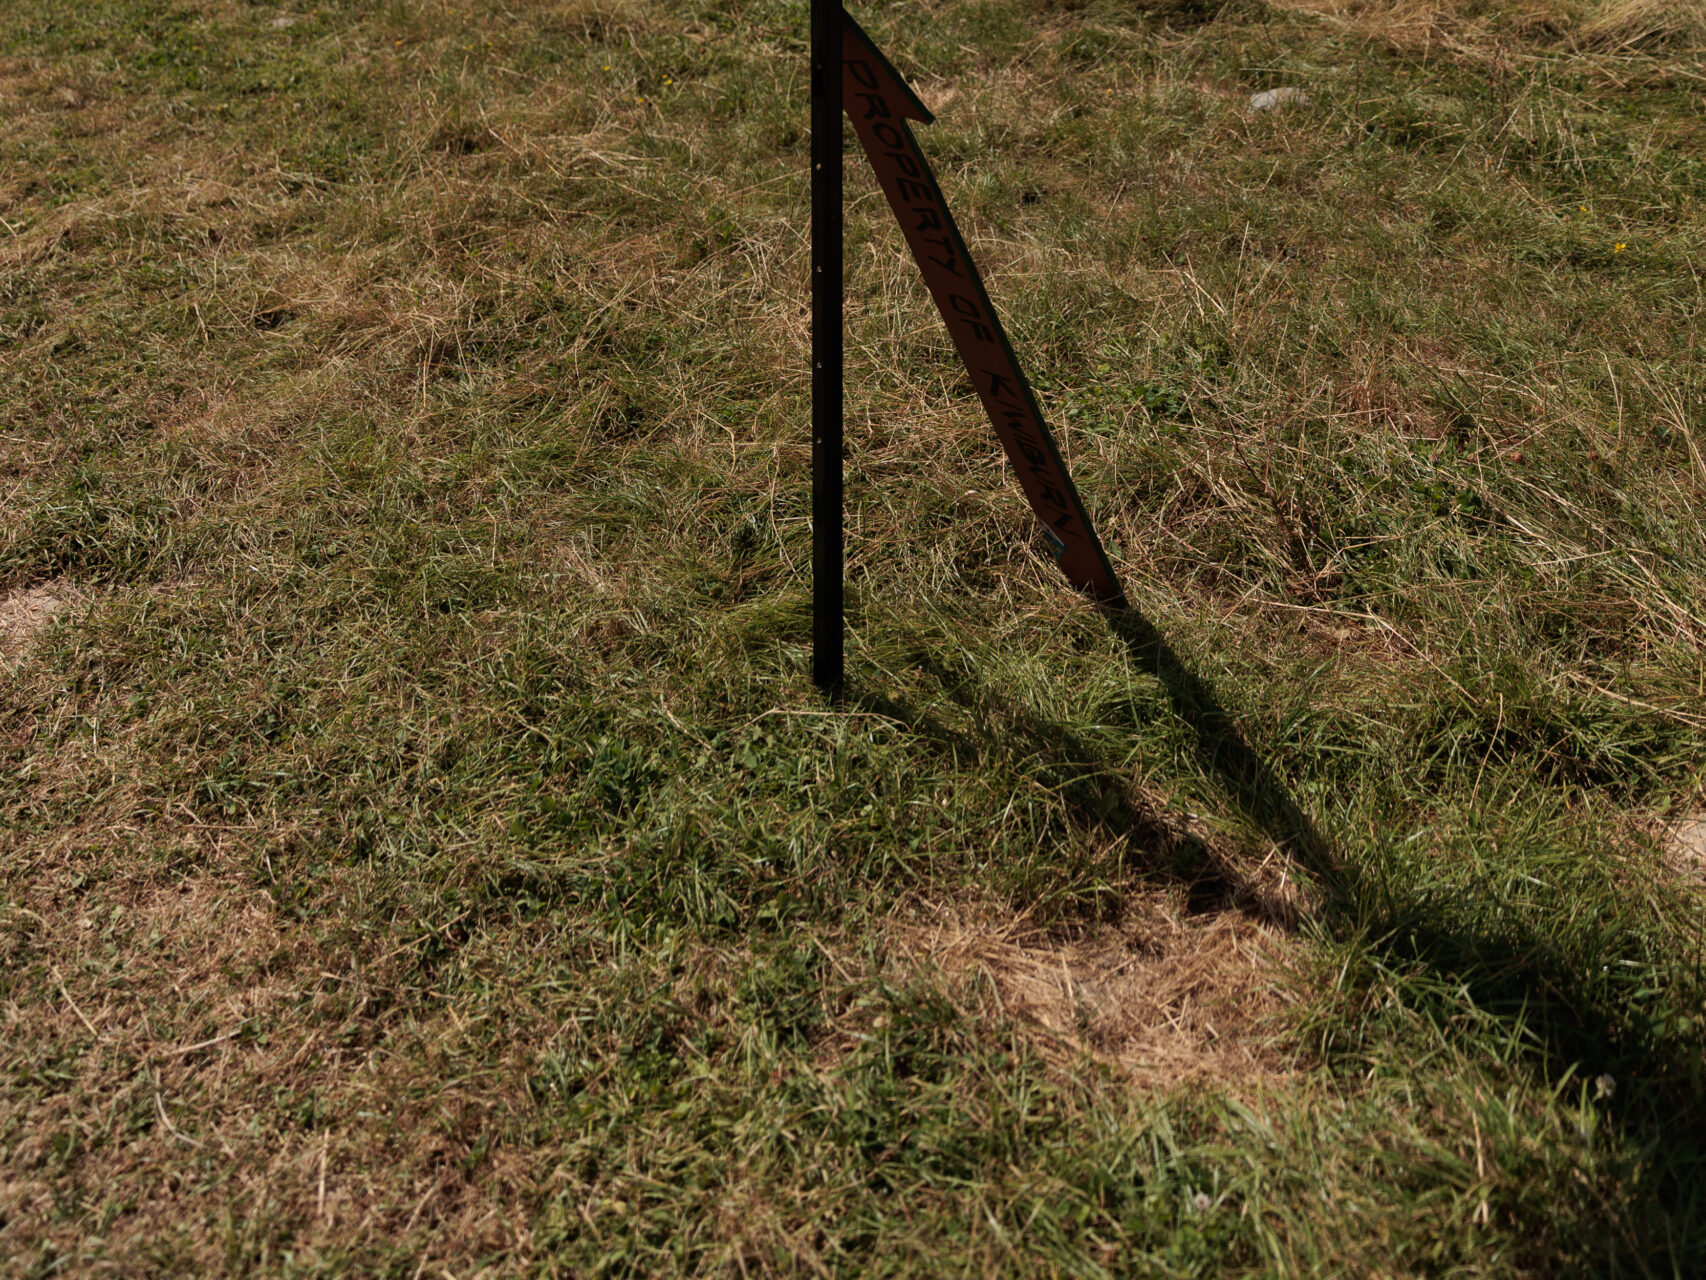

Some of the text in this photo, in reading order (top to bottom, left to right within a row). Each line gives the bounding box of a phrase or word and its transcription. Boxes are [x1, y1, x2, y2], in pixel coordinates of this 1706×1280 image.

[841, 59, 1083, 539] PROPERTY OF KIWIBURN
